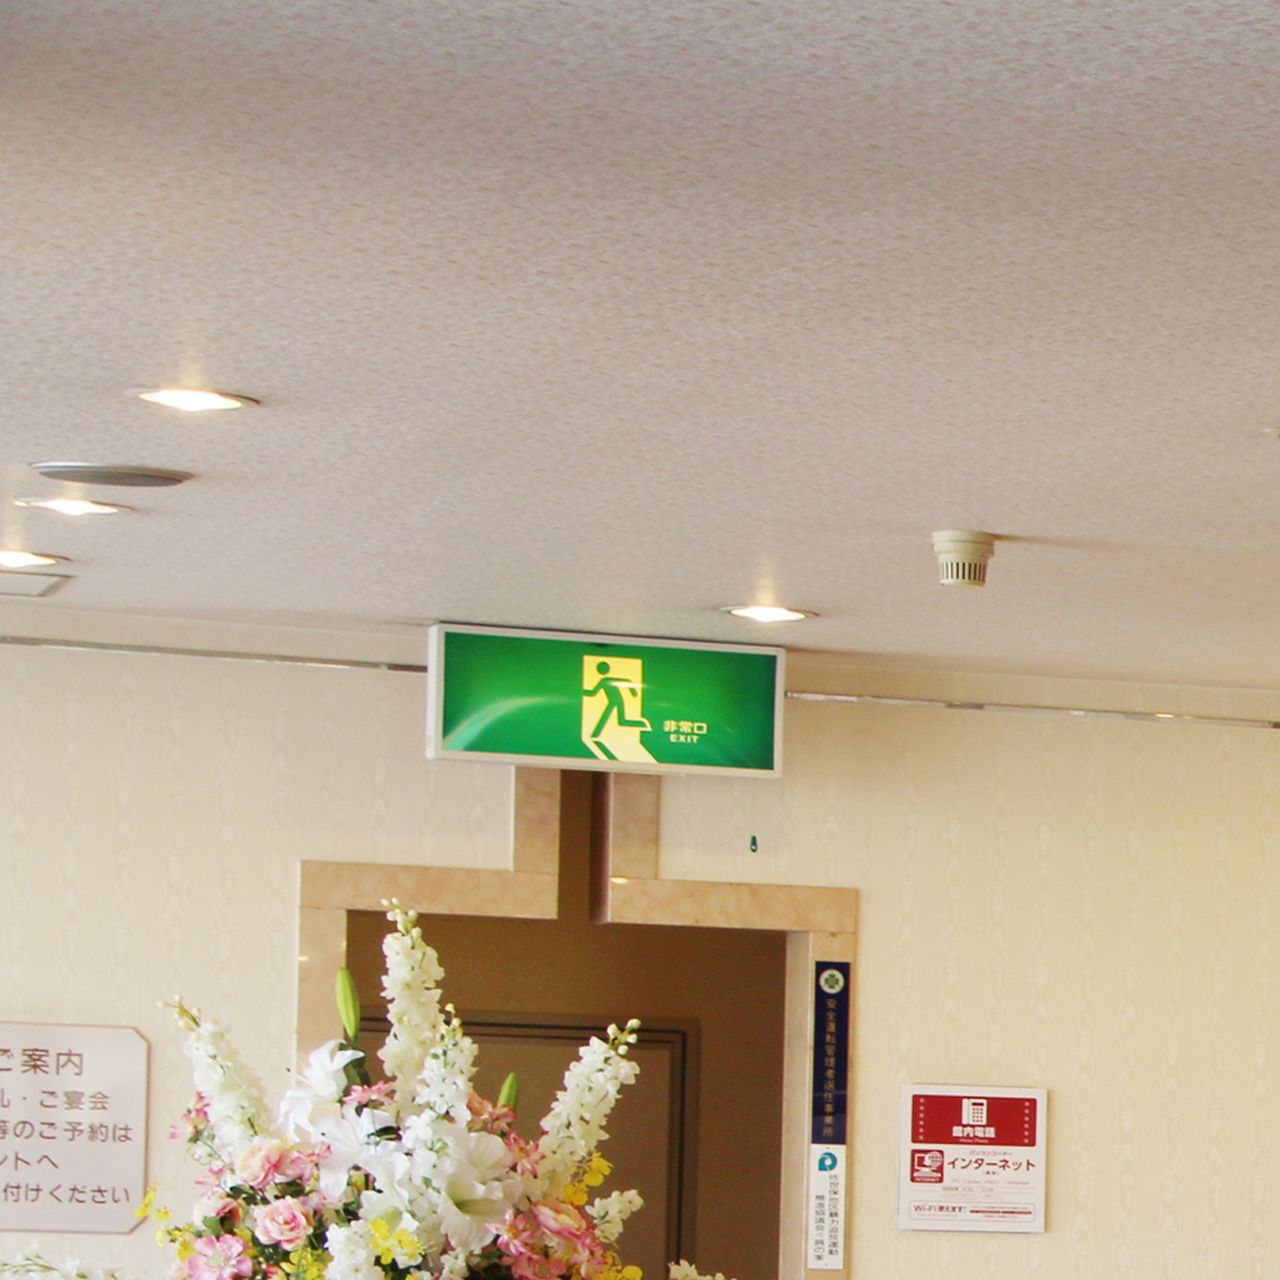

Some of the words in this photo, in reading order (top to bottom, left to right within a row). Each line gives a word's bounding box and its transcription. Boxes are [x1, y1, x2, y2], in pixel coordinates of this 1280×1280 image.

[664, 719, 708, 734] 非常口
[670, 733, 699, 744] EXIT
[947, 1157, 1036, 1171] インターネット
[3, 1182, 130, 1204] 付けください
